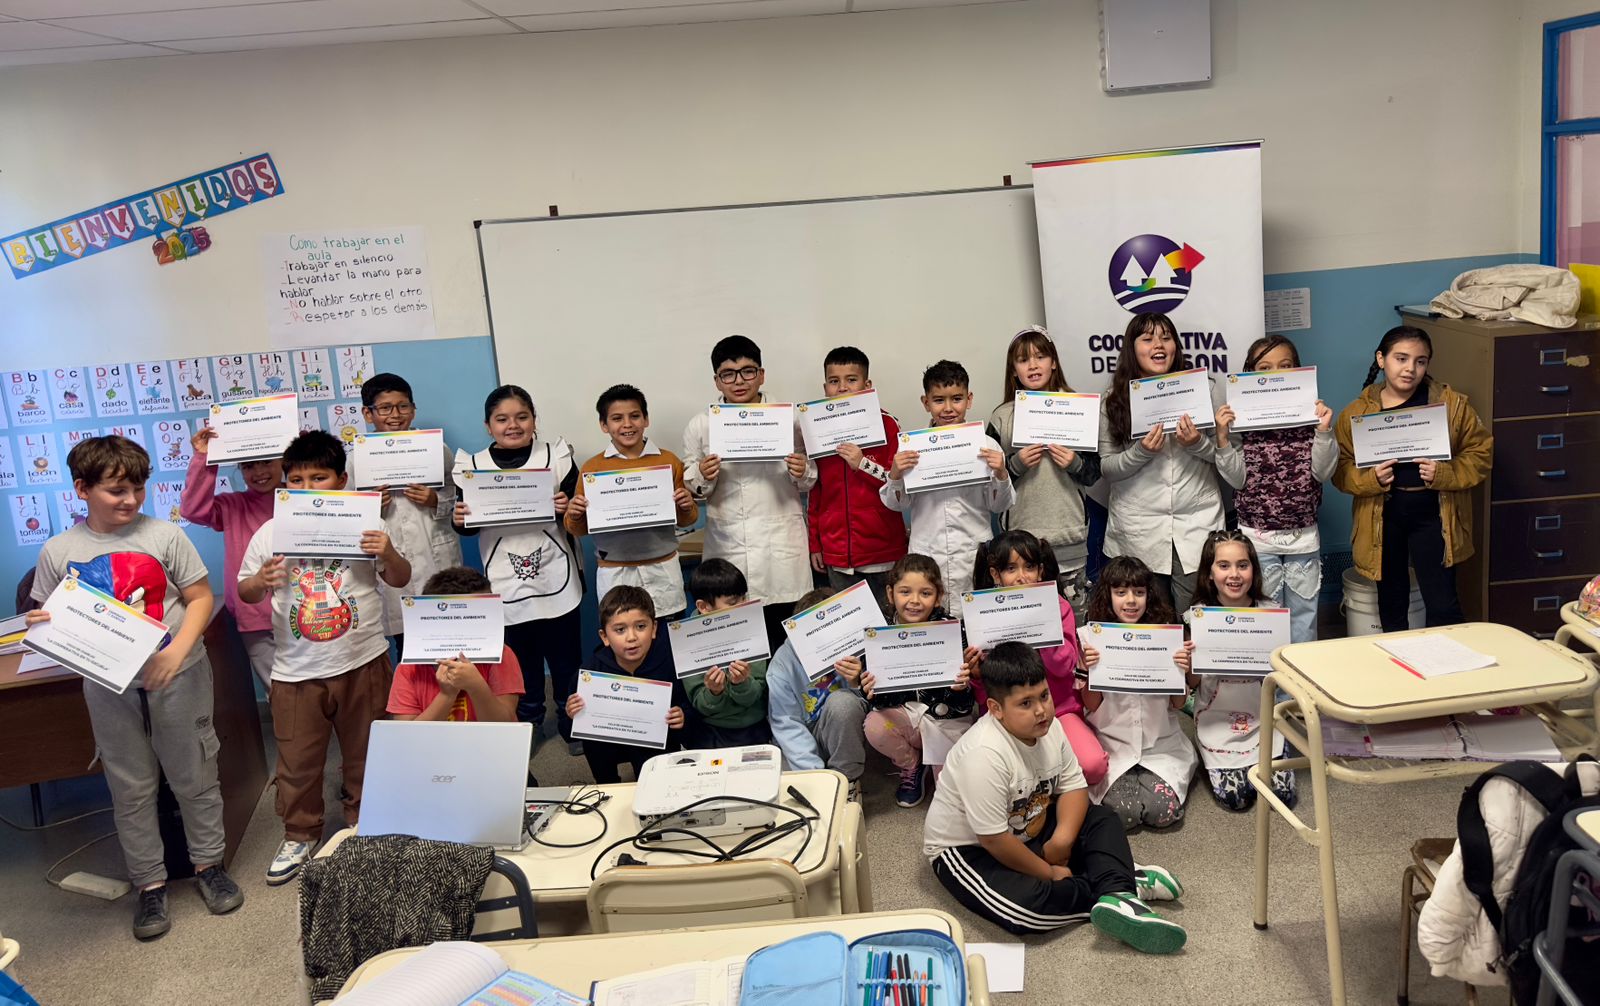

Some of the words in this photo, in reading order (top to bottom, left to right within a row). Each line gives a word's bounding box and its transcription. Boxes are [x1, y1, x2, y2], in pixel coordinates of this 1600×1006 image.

[13, 161, 275, 265] BIENVENIDOS
[152, 226, 212, 266] 2025
[323, 236, 371, 250] trabajar
[375, 237, 391, 245] en
[394, 234, 405, 244] el
[307, 250, 332, 261] aula
[353, 253, 394, 265] silencio
[347, 270, 357, 280] la
[362, 269, 391, 278] mano
[396, 267, 422, 279] para
[280, 287, 314, 299] hablar
[313, 295, 345, 308] hablar
[350, 292, 382, 303] sobre
[384, 288, 395, 300] el
[400, 287, 422, 297] otro
[361, 308, 367, 316] a
[371, 305, 388, 316] los
[344, 348, 351, 356] J
[360, 346, 365, 356] j
[219, 357, 230, 366] G
[234, 356, 242, 366] g
[260, 354, 270, 364] H
[274, 352, 282, 364] h
[302, 352, 306, 362] I
[314, 352, 318, 361] i
[136, 364, 146, 374] E
[152, 365, 161, 374] e
[178, 360, 187, 370] F
[194, 359, 198, 368] f
[54, 369, 64, 378] C
[70, 370, 78, 378] c
[96, 367, 106, 377] D
[111, 366, 120, 376] d
[12, 373, 23, 383] B
[28, 372, 37, 382] b
[222, 388, 253, 398] gusano
[302, 384, 329, 392] isla
[138, 397, 170, 405] elefante
[181, 394, 212, 402] foca
[102, 400, 128, 408] dado
[334, 406, 344, 415] S
[350, 406, 357, 414] s
[112, 428, 124, 437] N
[128, 427, 137, 436] n
[158, 422, 170, 432] O
[173, 422, 182, 431] o
[26, 436, 34, 446] L
[69, 432, 80, 440] M
[158, 482, 168, 492] W
[16, 496, 25, 506] T
[32, 496, 36, 505] t
[20, 528, 48, 537] tomate
